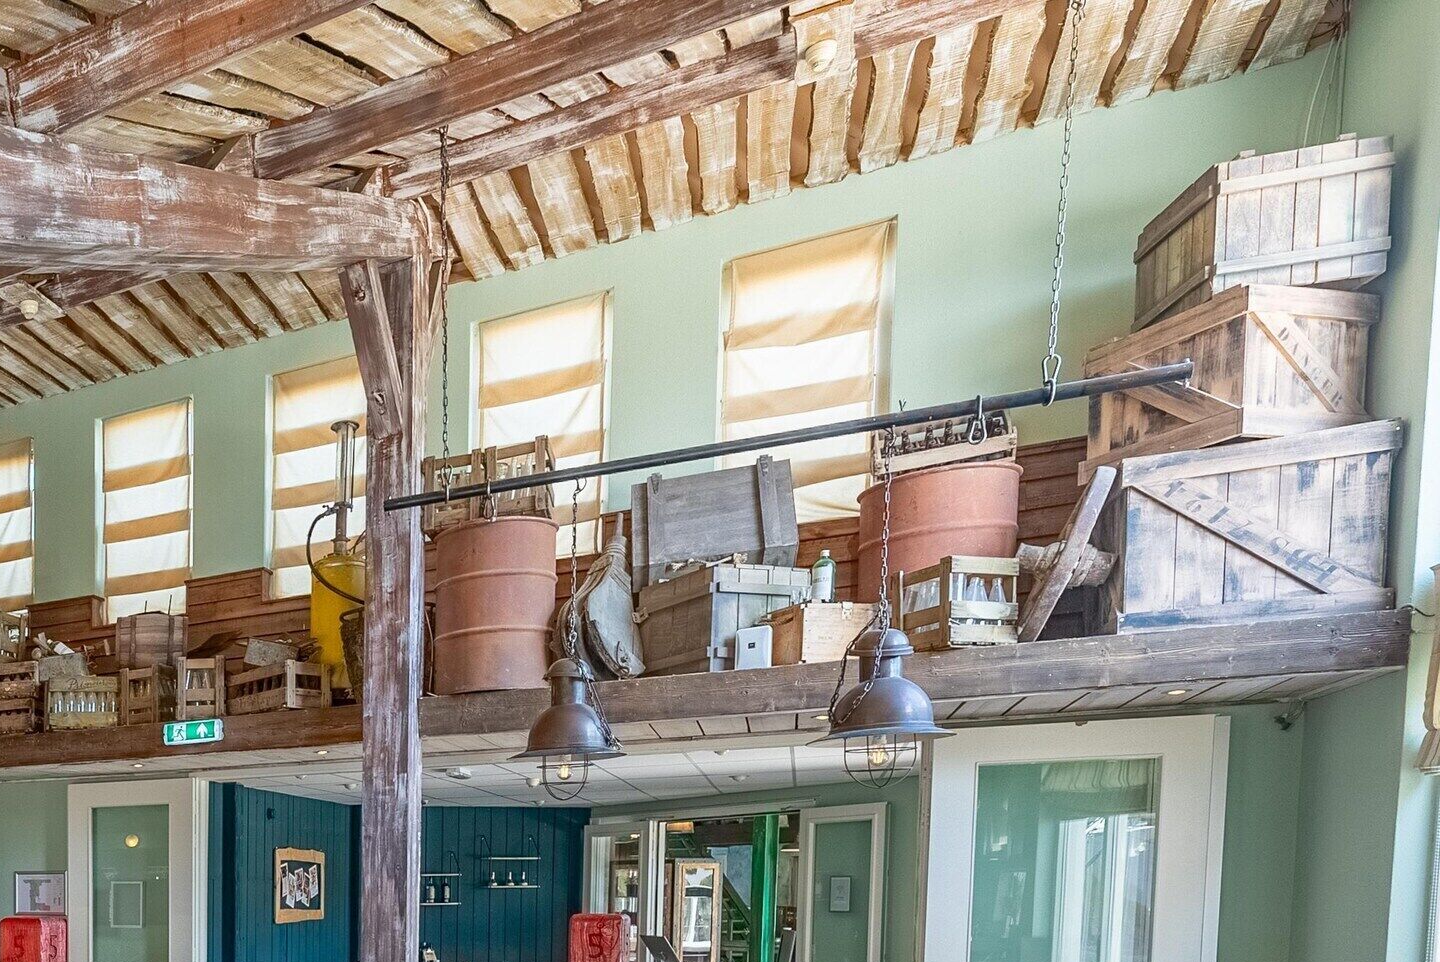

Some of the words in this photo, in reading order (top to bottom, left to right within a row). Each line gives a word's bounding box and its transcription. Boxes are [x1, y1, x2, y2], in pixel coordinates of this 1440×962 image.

[13, 934, 25, 959] 5
[48, 934, 58, 960] 5
[588, 932, 604, 959] 5
